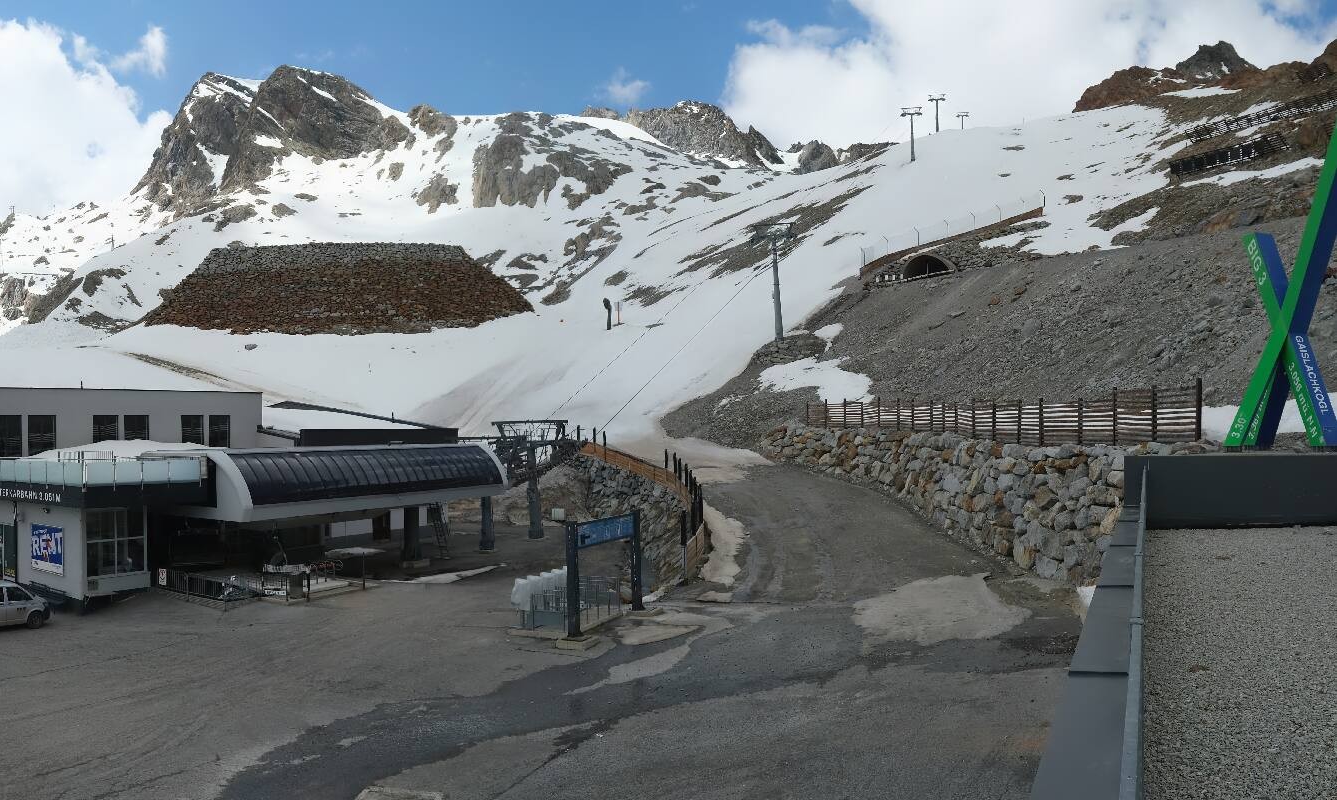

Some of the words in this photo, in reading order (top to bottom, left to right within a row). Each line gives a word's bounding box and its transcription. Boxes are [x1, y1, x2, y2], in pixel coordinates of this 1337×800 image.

[1247, 238, 1261, 272] BIG
[1258, 271, 1267, 286] 3
[1295, 335, 1329, 415] GAISLACHKOGL
